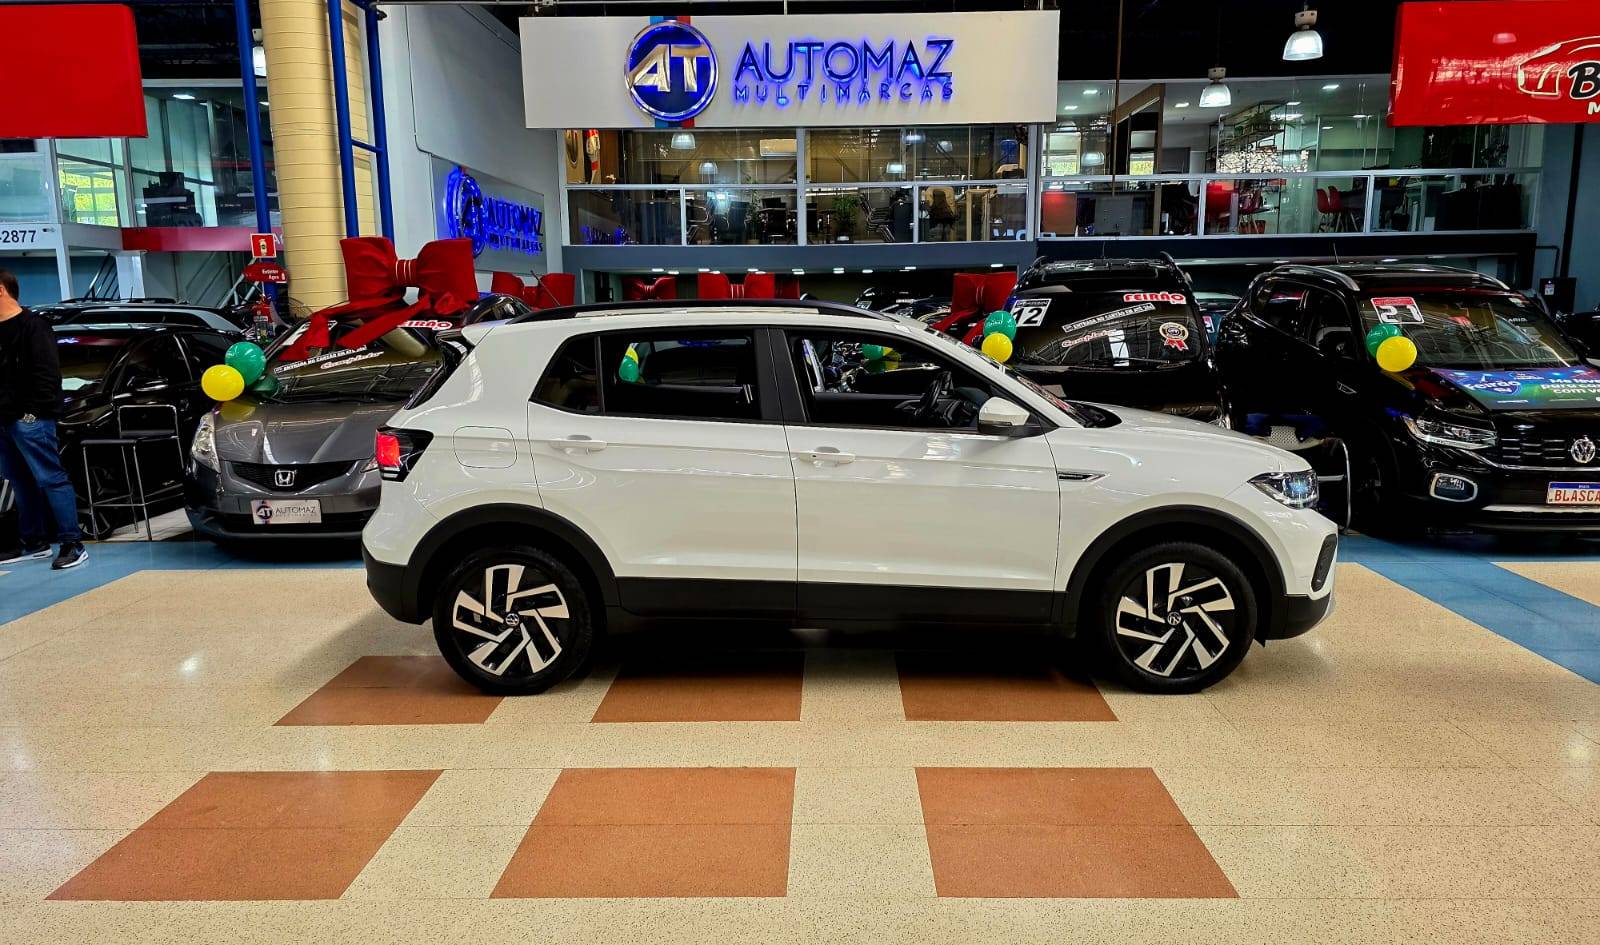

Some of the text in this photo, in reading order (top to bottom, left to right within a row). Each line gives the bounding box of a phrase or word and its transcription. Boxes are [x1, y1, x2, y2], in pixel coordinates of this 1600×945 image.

[628, 44, 709, 92] AT
[734, 39, 954, 81] AUTOMAZ
[734, 82, 954, 100] MULTIMARCAS
[1124, 291, 1186, 302] FEIRÃO
[1013, 307, 1043, 324] 12
[276, 506, 316, 514] AUTOMAZ
